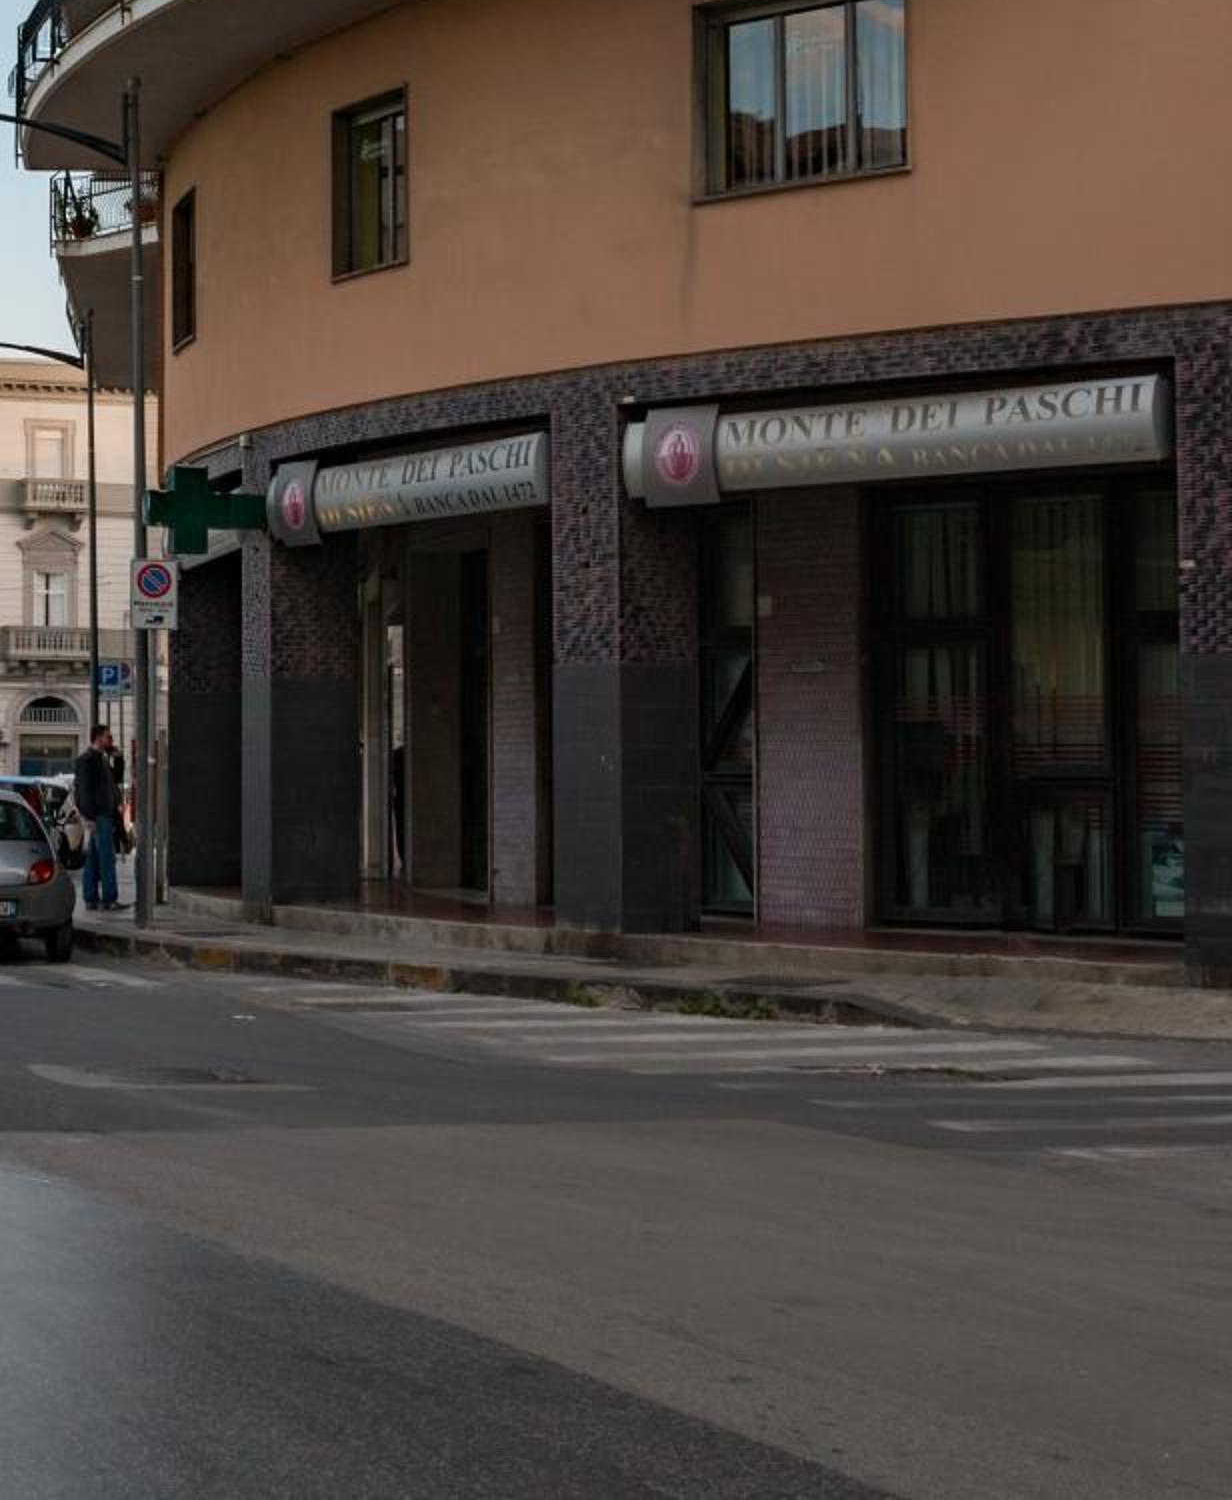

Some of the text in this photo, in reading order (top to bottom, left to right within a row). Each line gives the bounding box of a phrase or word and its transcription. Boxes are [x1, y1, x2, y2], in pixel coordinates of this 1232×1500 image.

[726, 384, 1143, 449] MONTE DEI PASCHI
[321, 440, 534, 494] MONTE DEI PASCHI
[775, 445, 897, 475] SIENA
[911, 441, 1010, 469] BANCA
[416, 490, 467, 516] BANCA
[467, 485, 497, 508] DAL
[502, 480, 539, 501] 1472
[101, 667, 114, 683] P
